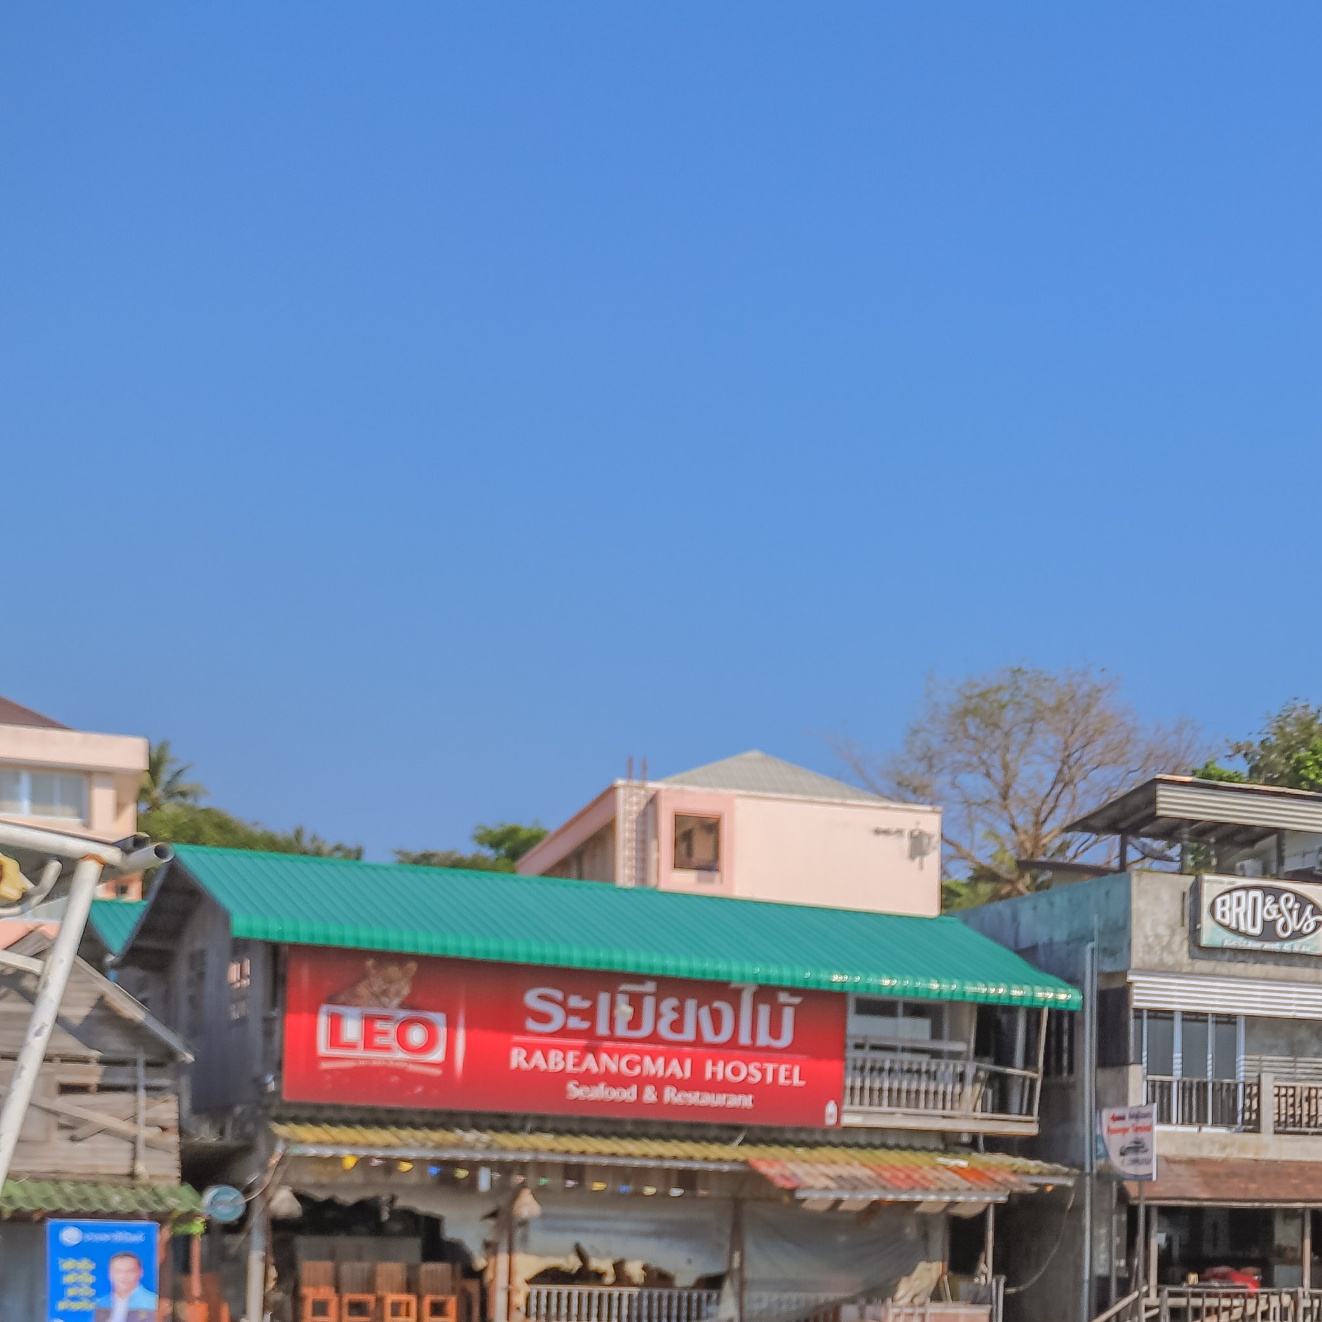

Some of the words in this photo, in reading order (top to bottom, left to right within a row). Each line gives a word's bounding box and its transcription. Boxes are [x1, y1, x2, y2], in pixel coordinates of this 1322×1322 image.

[329, 1012, 438, 1055] LEO
[523, 981, 803, 1048] ระเบียงไม้
[509, 1047, 692, 1079] RABEANGMAI
[704, 1060, 807, 1087] HOSTEL
[566, 1080, 638, 1102] Seafood
[642, 1085, 658, 1105] &
[663, 1086, 755, 1109] Restaurant
